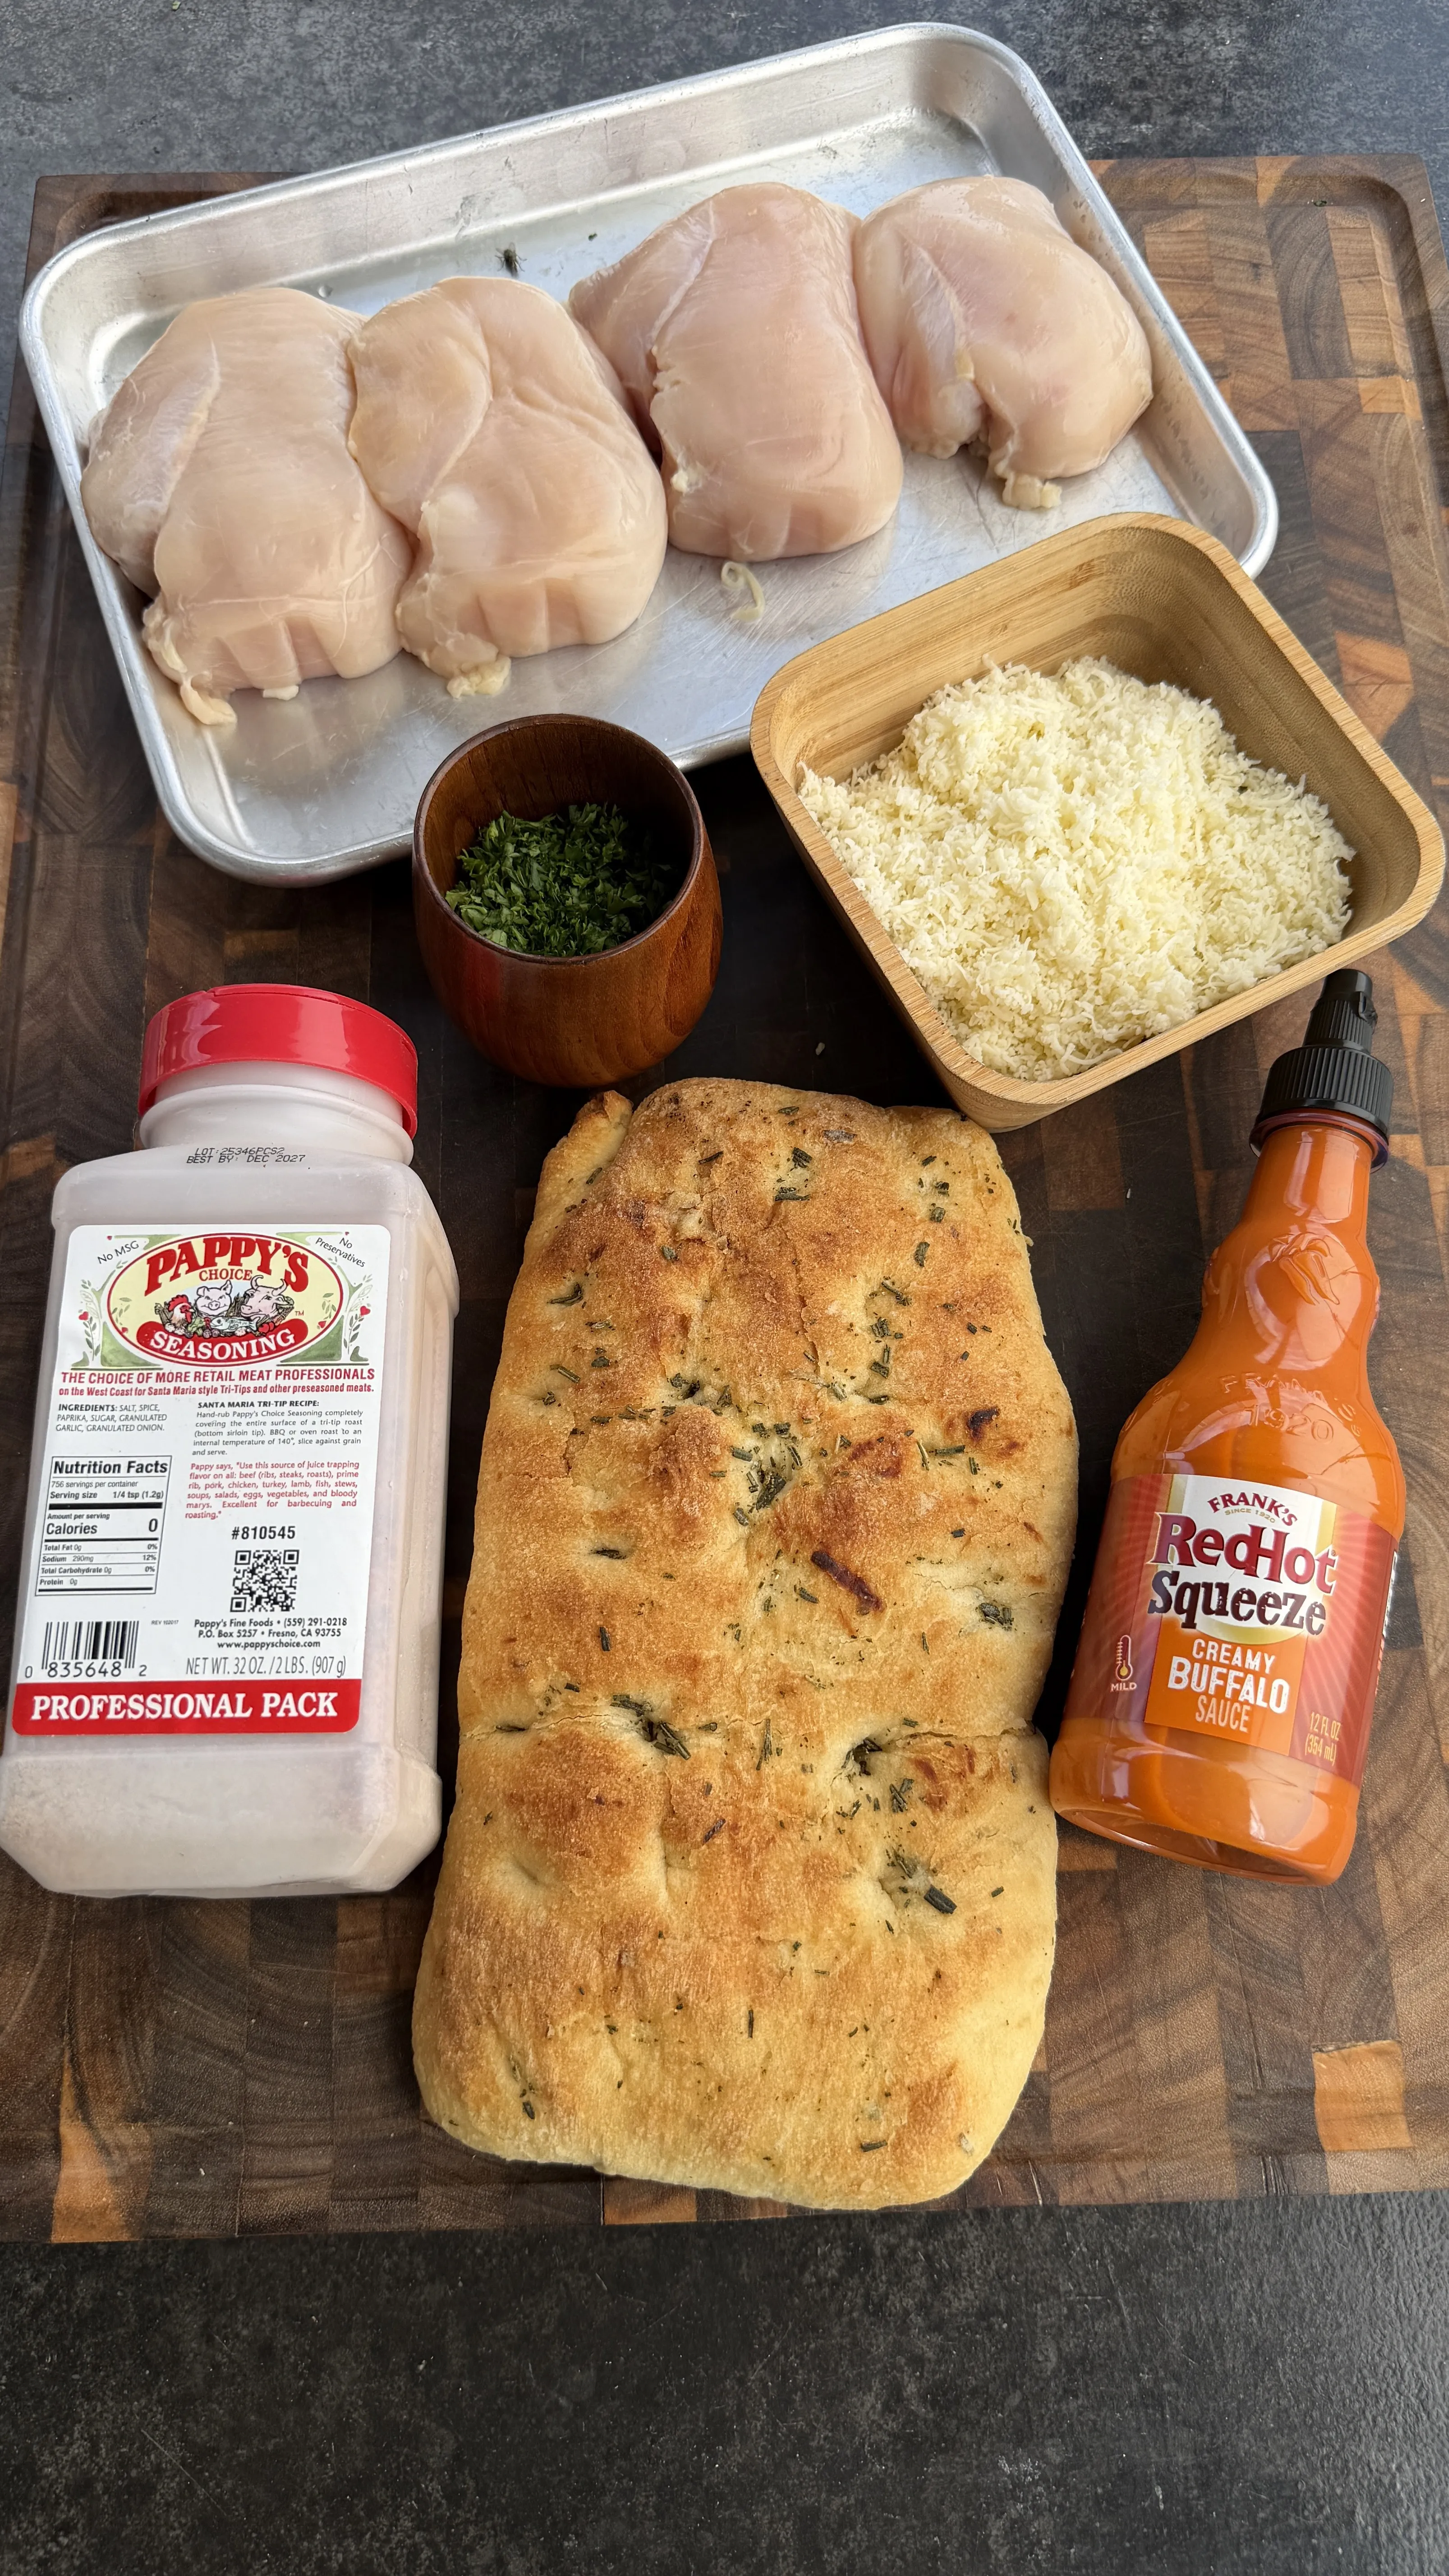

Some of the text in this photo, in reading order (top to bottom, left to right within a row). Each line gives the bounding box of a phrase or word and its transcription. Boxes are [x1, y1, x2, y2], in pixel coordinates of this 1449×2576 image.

[339, 1237, 352, 1249] No
[97, 1241, 139, 1264] No MSG
[315, 1237, 366, 1267] Preservatives
[144, 1237, 309, 1296] PAPPY'S
[199, 1268, 253, 1281] CHOICE
[150, 1328, 294, 1360] SEASONING
[61, 1368, 375, 1384] THE CHOICE OF MORE RETAIL MEAT PROFESSIONALS
[71, 1386, 84, 1396] the
[87, 1387, 108, 1396] West
[109, 1387, 133, 1396] Coast
[134, 1386, 146, 1396] for
[147, 1386, 171, 1396] Santa
[172, 1385, 196, 1395] Maria
[198, 1385, 218, 1396] style
[220, 1384, 251, 1395] Tri-Tips
[252, 1384, 268, 1393] and
[269, 1384, 291, 1393] other
[292, 1383, 345, 1394] preseasoned
[346, 1383, 374, 1392] meats.
[58, 1403, 160, 1412] INGREDIENTS: SALT, SPICE,
[232, 1410, 258, 1419] Pappy's
[287, 1409, 322, 1417] Seasoning
[325, 1409, 363, 1417] completely
[56, 1413, 167, 1422] PAPRIKA, SUGAR, GRANULATED
[195, 1420, 226, 1428] covering
[320, 1418, 340, 1426] tri-tip
[55, 1423, 165, 1433] GARLIC, GRANULATED ONION.
[252, 1429, 265, 1437] tip).
[222, 1439, 265, 1447] temperature
[315, 1437, 340, 1446] against
[342, 1437, 361, 1445] grain
[53, 1460, 168, 1474] Nutrition Facts
[190, 1463, 214, 1472] Pappy
[255, 1461, 268, 1469] this
[297, 1460, 306, 1468] of
[306, 1460, 325, 1470] juice
[327, 1460, 359, 1470] trapping
[65, 1480, 93, 1489] servings
[50, 1490, 80, 1500] Serving
[82, 1490, 97, 1499] size
[127, 1490, 139, 1500] tsp
[141, 1490, 164, 1500] (1.2g)
[1207, 1492, 1297, 1526] FRANK'S
[86, 1512, 110, 1520] serving
[1255, 1510, 1276, 1523] 1920
[46, 1518, 158, 1535] Calories 0
[231, 1525, 295, 1540] #810545
[58, 1566, 102, 1574] Carbohydrate
[104, 1566, 112, 1574] 0g
[1147, 1570, 1326, 1635] Squeeze
[193, 1617, 347, 1630] Pappy's Fine Foods (559) 291-0218
[198, 1628, 341, 1638] P.O. Box 5257 Fresno, CA 93755
[216, 1638, 320, 1651] www.pappyschoice.com
[1192, 1638, 1275, 1674] CREAMY
[24, 1661, 147, 1678] 0 835648 2
[185, 1656, 209, 1674] NET
[211, 1656, 230, 1674] WT.
[233, 1656, 246, 1674] 32
[248, 1656, 266, 1674] OZ.
[284, 1656, 308, 1674] LBS.
[312, 1655, 334, 1676] (907
[336, 1655, 346, 1678] g)
[1111, 1682, 1137, 1691] MILD
[1168, 1656, 1289, 1714] BUFFALO
[30, 1692, 339, 1721] PROFESSIONAL PACK
[1196, 1695, 1251, 1733] SAUCE
[1310, 1711, 1341, 1741] 12 FL OZ
[1305, 1733, 1337, 1766] (354 mL)
